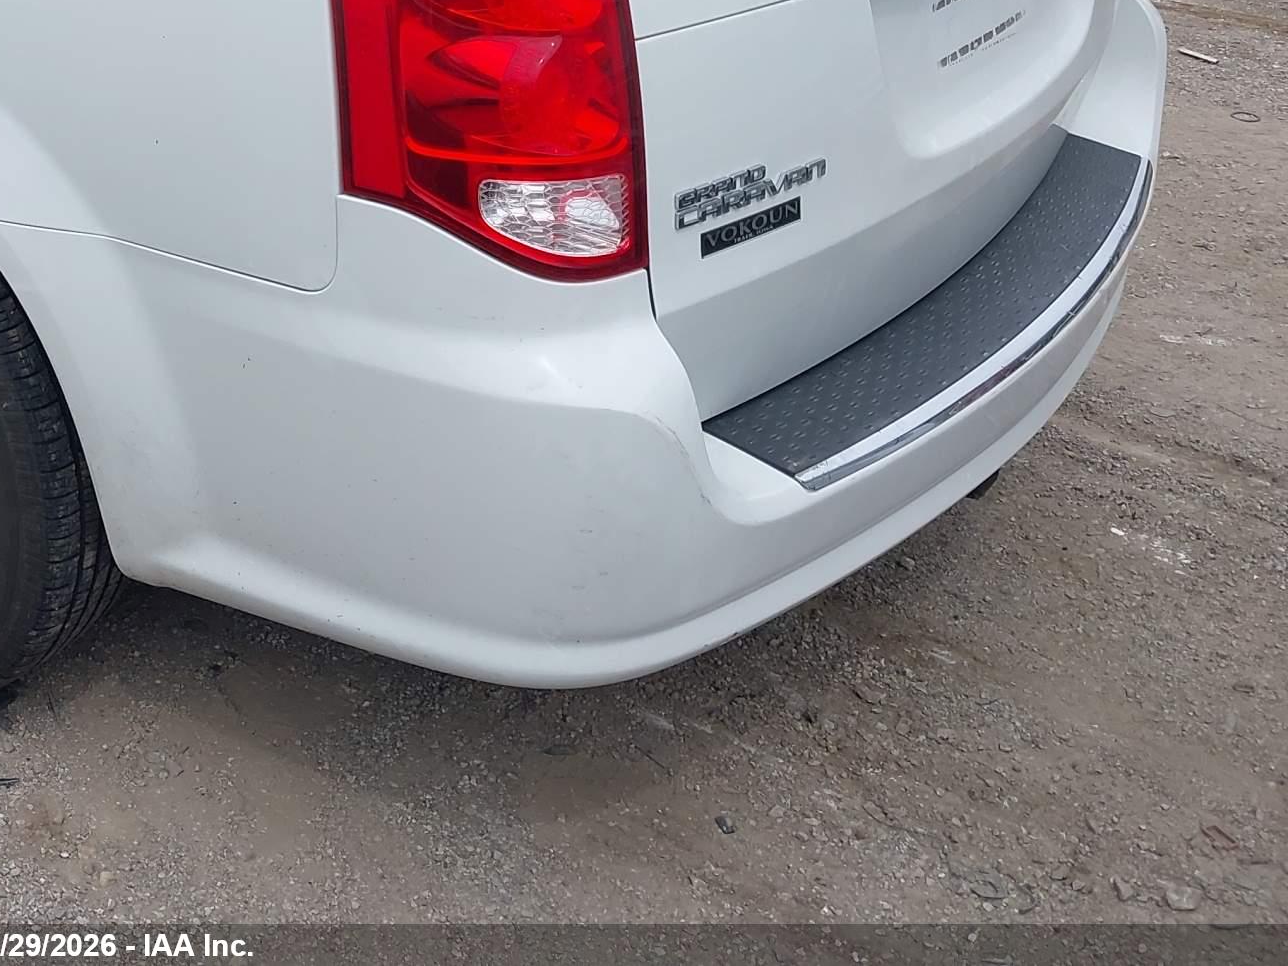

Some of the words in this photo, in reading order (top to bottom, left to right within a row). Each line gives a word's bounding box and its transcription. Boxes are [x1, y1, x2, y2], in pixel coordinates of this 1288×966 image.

[674, 163, 766, 211] GRAND
[674, 156, 827, 231] CARAVAN
[704, 199, 800, 247] VOKOUN
